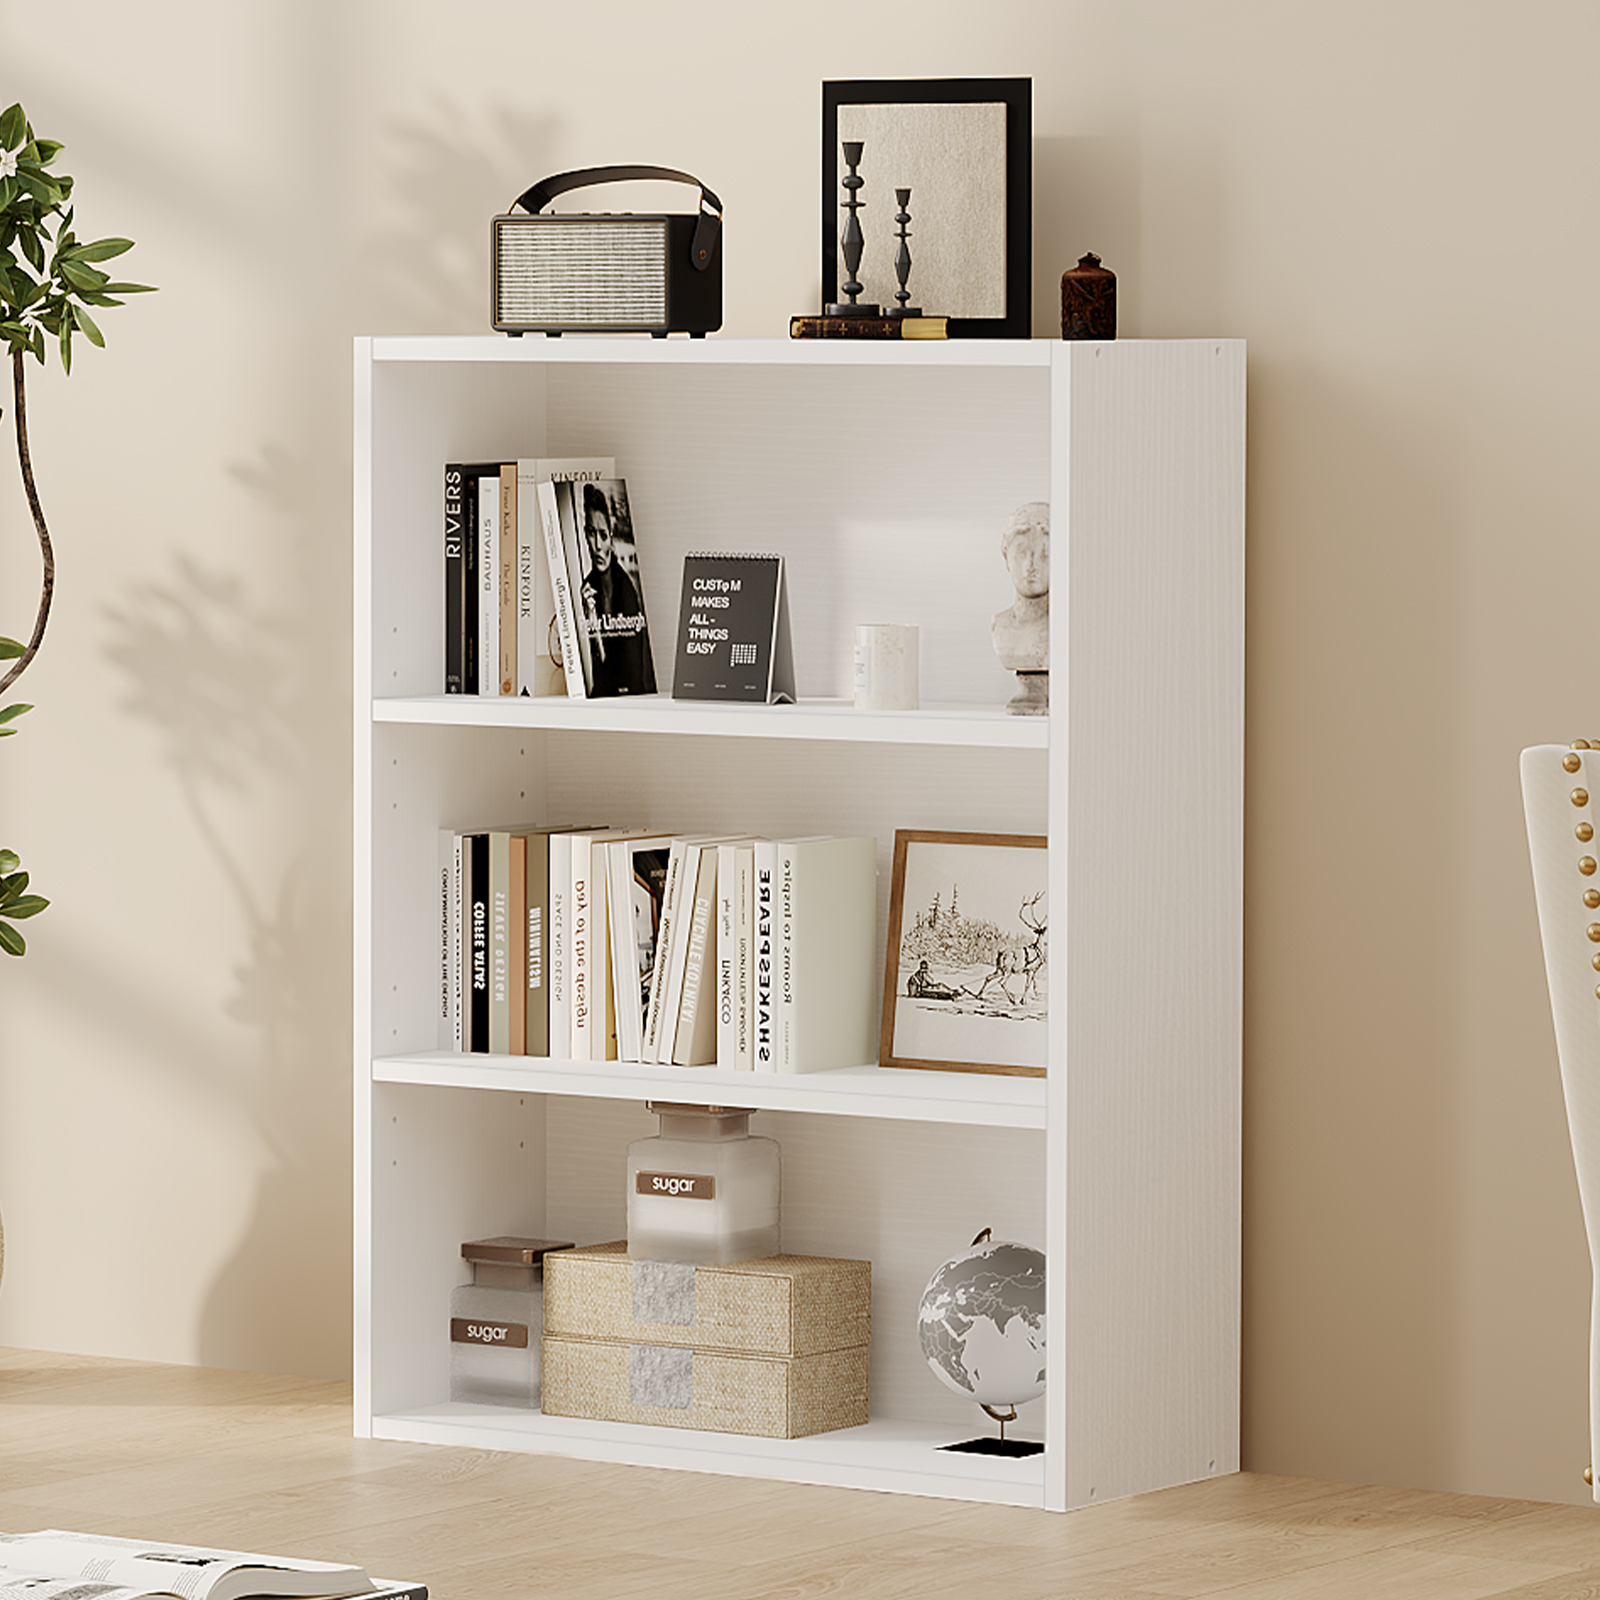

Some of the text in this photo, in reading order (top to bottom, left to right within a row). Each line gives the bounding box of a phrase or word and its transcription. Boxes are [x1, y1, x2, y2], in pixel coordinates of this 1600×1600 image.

[446, 471, 461, 558] RIVERS
[484, 519, 492, 591] BAUHAUS
[520, 545, 530, 618] KINFOLK
[691, 596, 730, 608] MAKES
[556, 577, 574, 675] Peter Lindbergh
[602, 611, 646, 632] Lindbergh
[688, 628, 728, 640] THINGS
[686, 642, 716, 654] EASY
[652, 1175, 696, 1194] sugar
[467, 1324, 508, 1342] sugar
